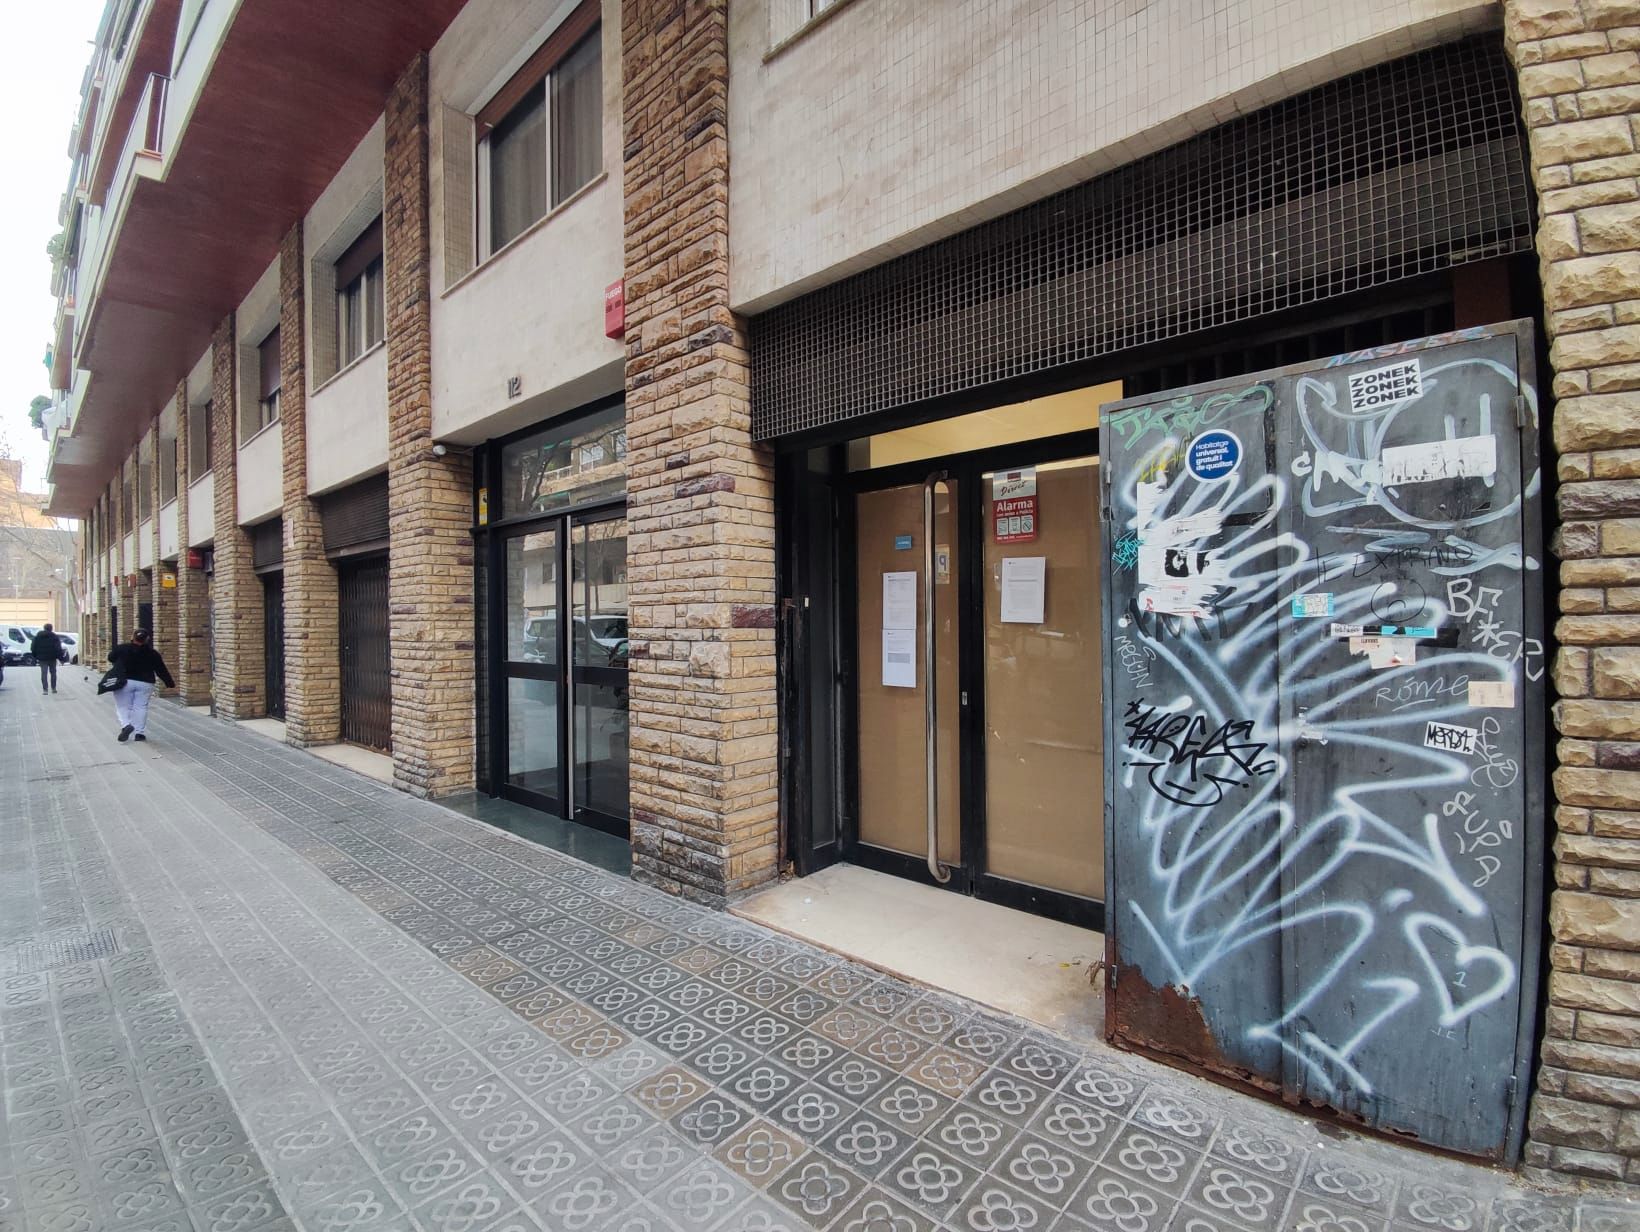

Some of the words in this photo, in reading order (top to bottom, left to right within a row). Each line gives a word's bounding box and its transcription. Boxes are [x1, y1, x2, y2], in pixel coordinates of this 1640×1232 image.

[1350, 364, 1417, 388] ZONEK
[1352, 375, 1418, 398] ZONEK
[508, 376, 522, 400] 12
[1353, 386, 1420, 409] ZONEK
[1195, 441, 1229, 450] Habitatge
[1195, 456, 1219, 466] gratuit
[996, 500, 1034, 513] Alarma
